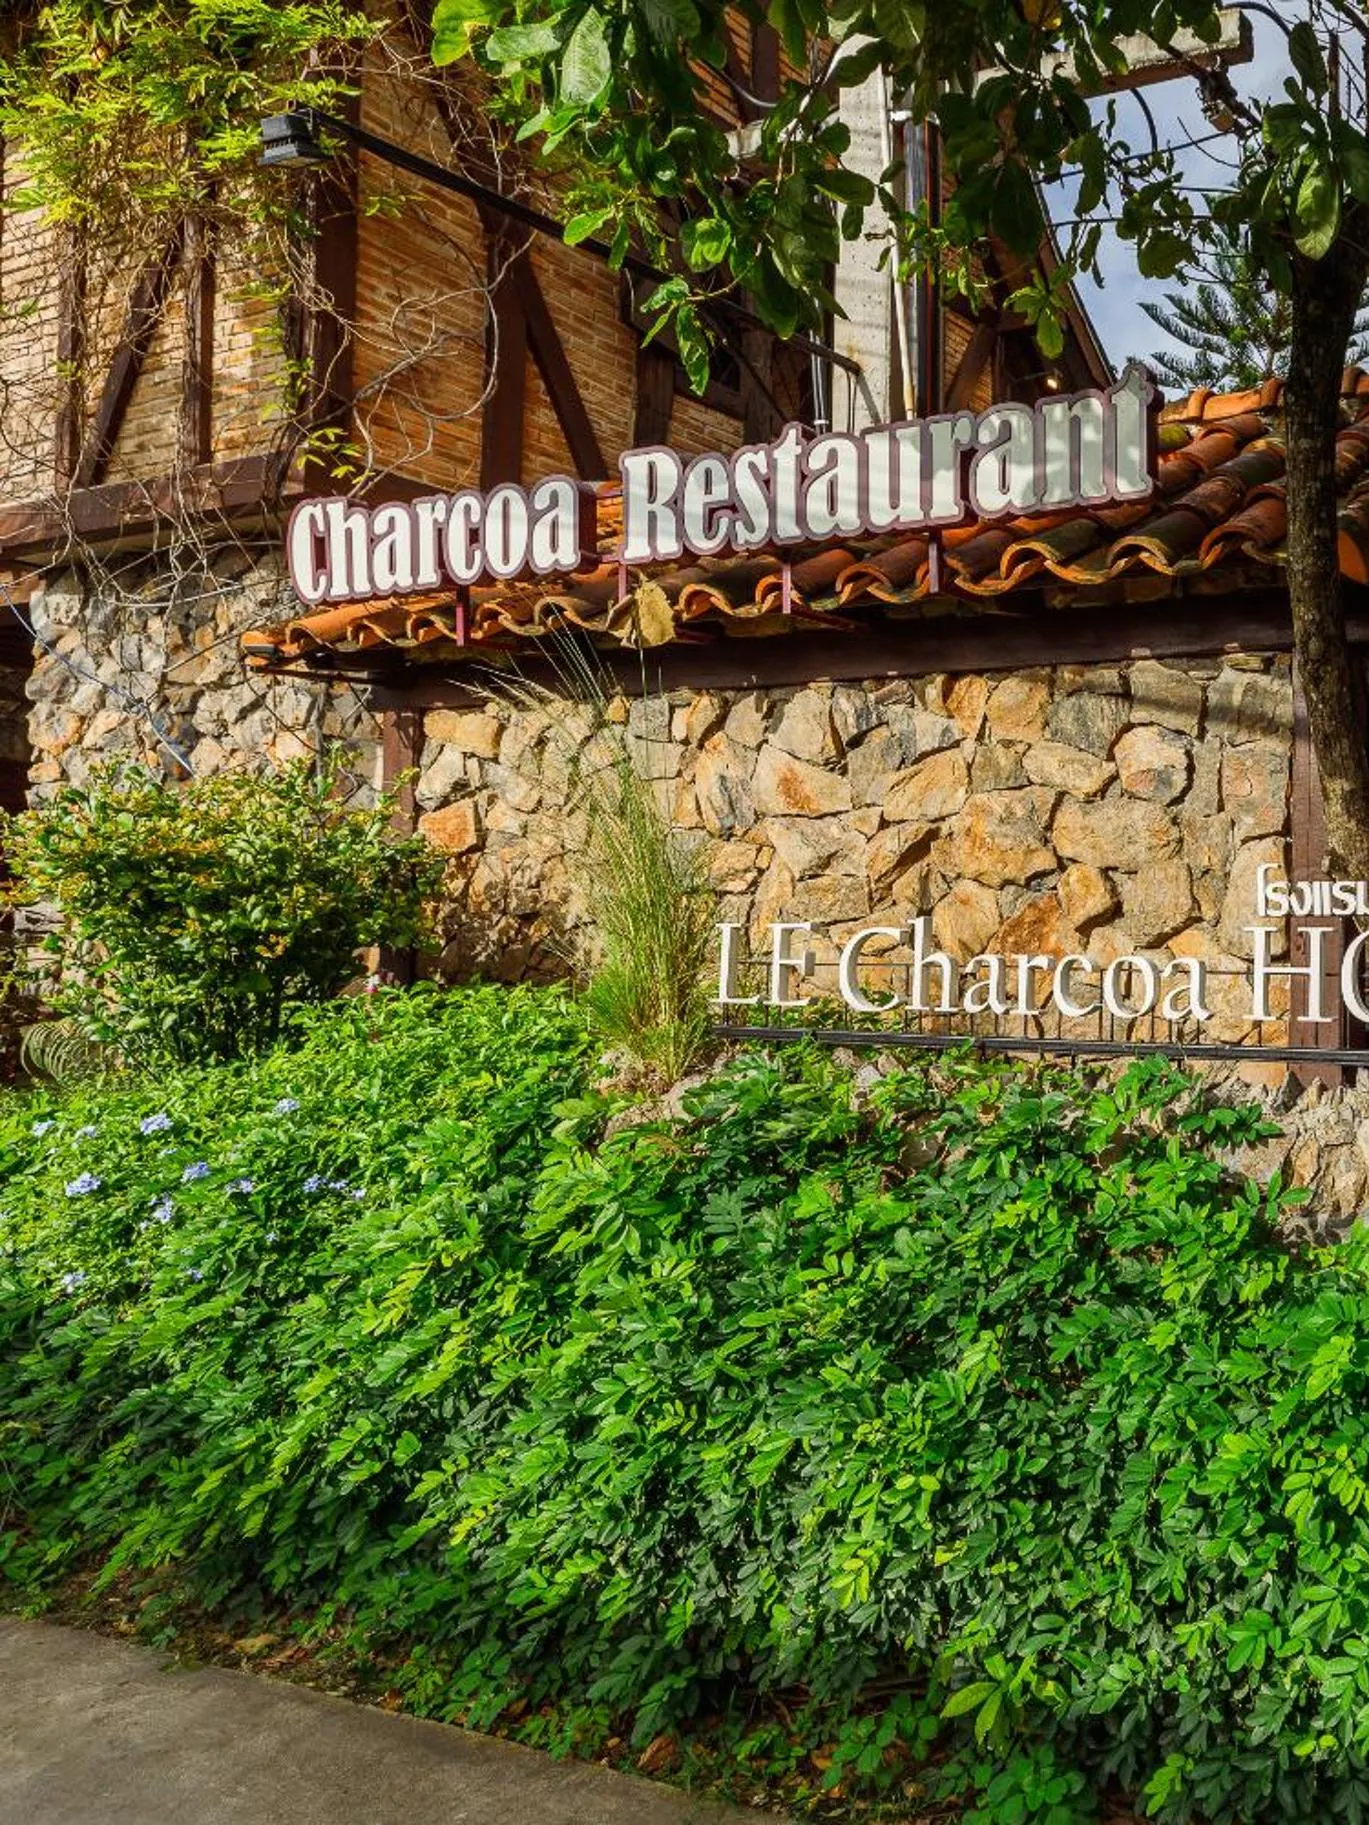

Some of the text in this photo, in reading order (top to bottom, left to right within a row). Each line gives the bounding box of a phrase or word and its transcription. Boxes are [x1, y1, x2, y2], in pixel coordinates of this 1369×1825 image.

[289, 364, 1158, 602] Charcoa Restaurant
[709, 922, 817, 1006] LE
[839, 915, 1213, 1021] Charcoa
